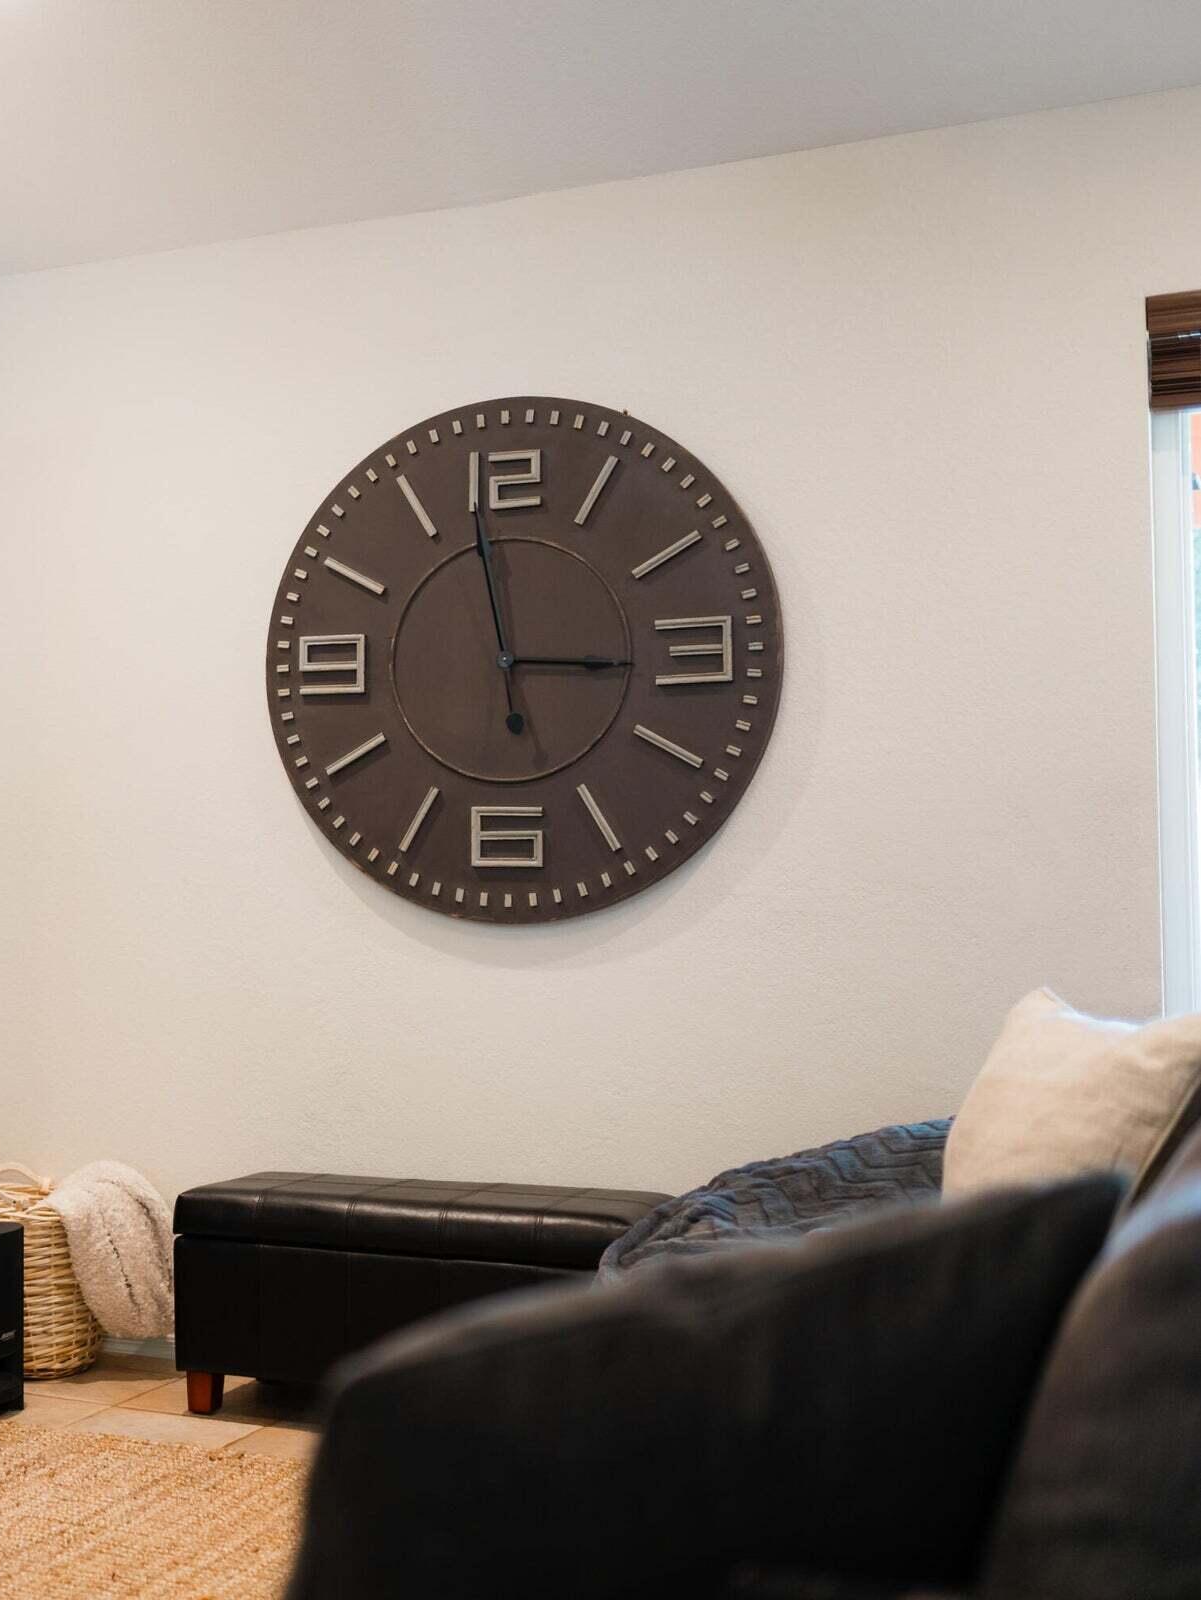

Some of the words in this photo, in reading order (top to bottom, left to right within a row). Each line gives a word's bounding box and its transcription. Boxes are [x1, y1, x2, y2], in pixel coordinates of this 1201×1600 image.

[469, 449, 541, 511] 12
[300, 634, 365, 695] 9
[654, 615, 733, 685] 3
[471, 806, 543, 867] 6
